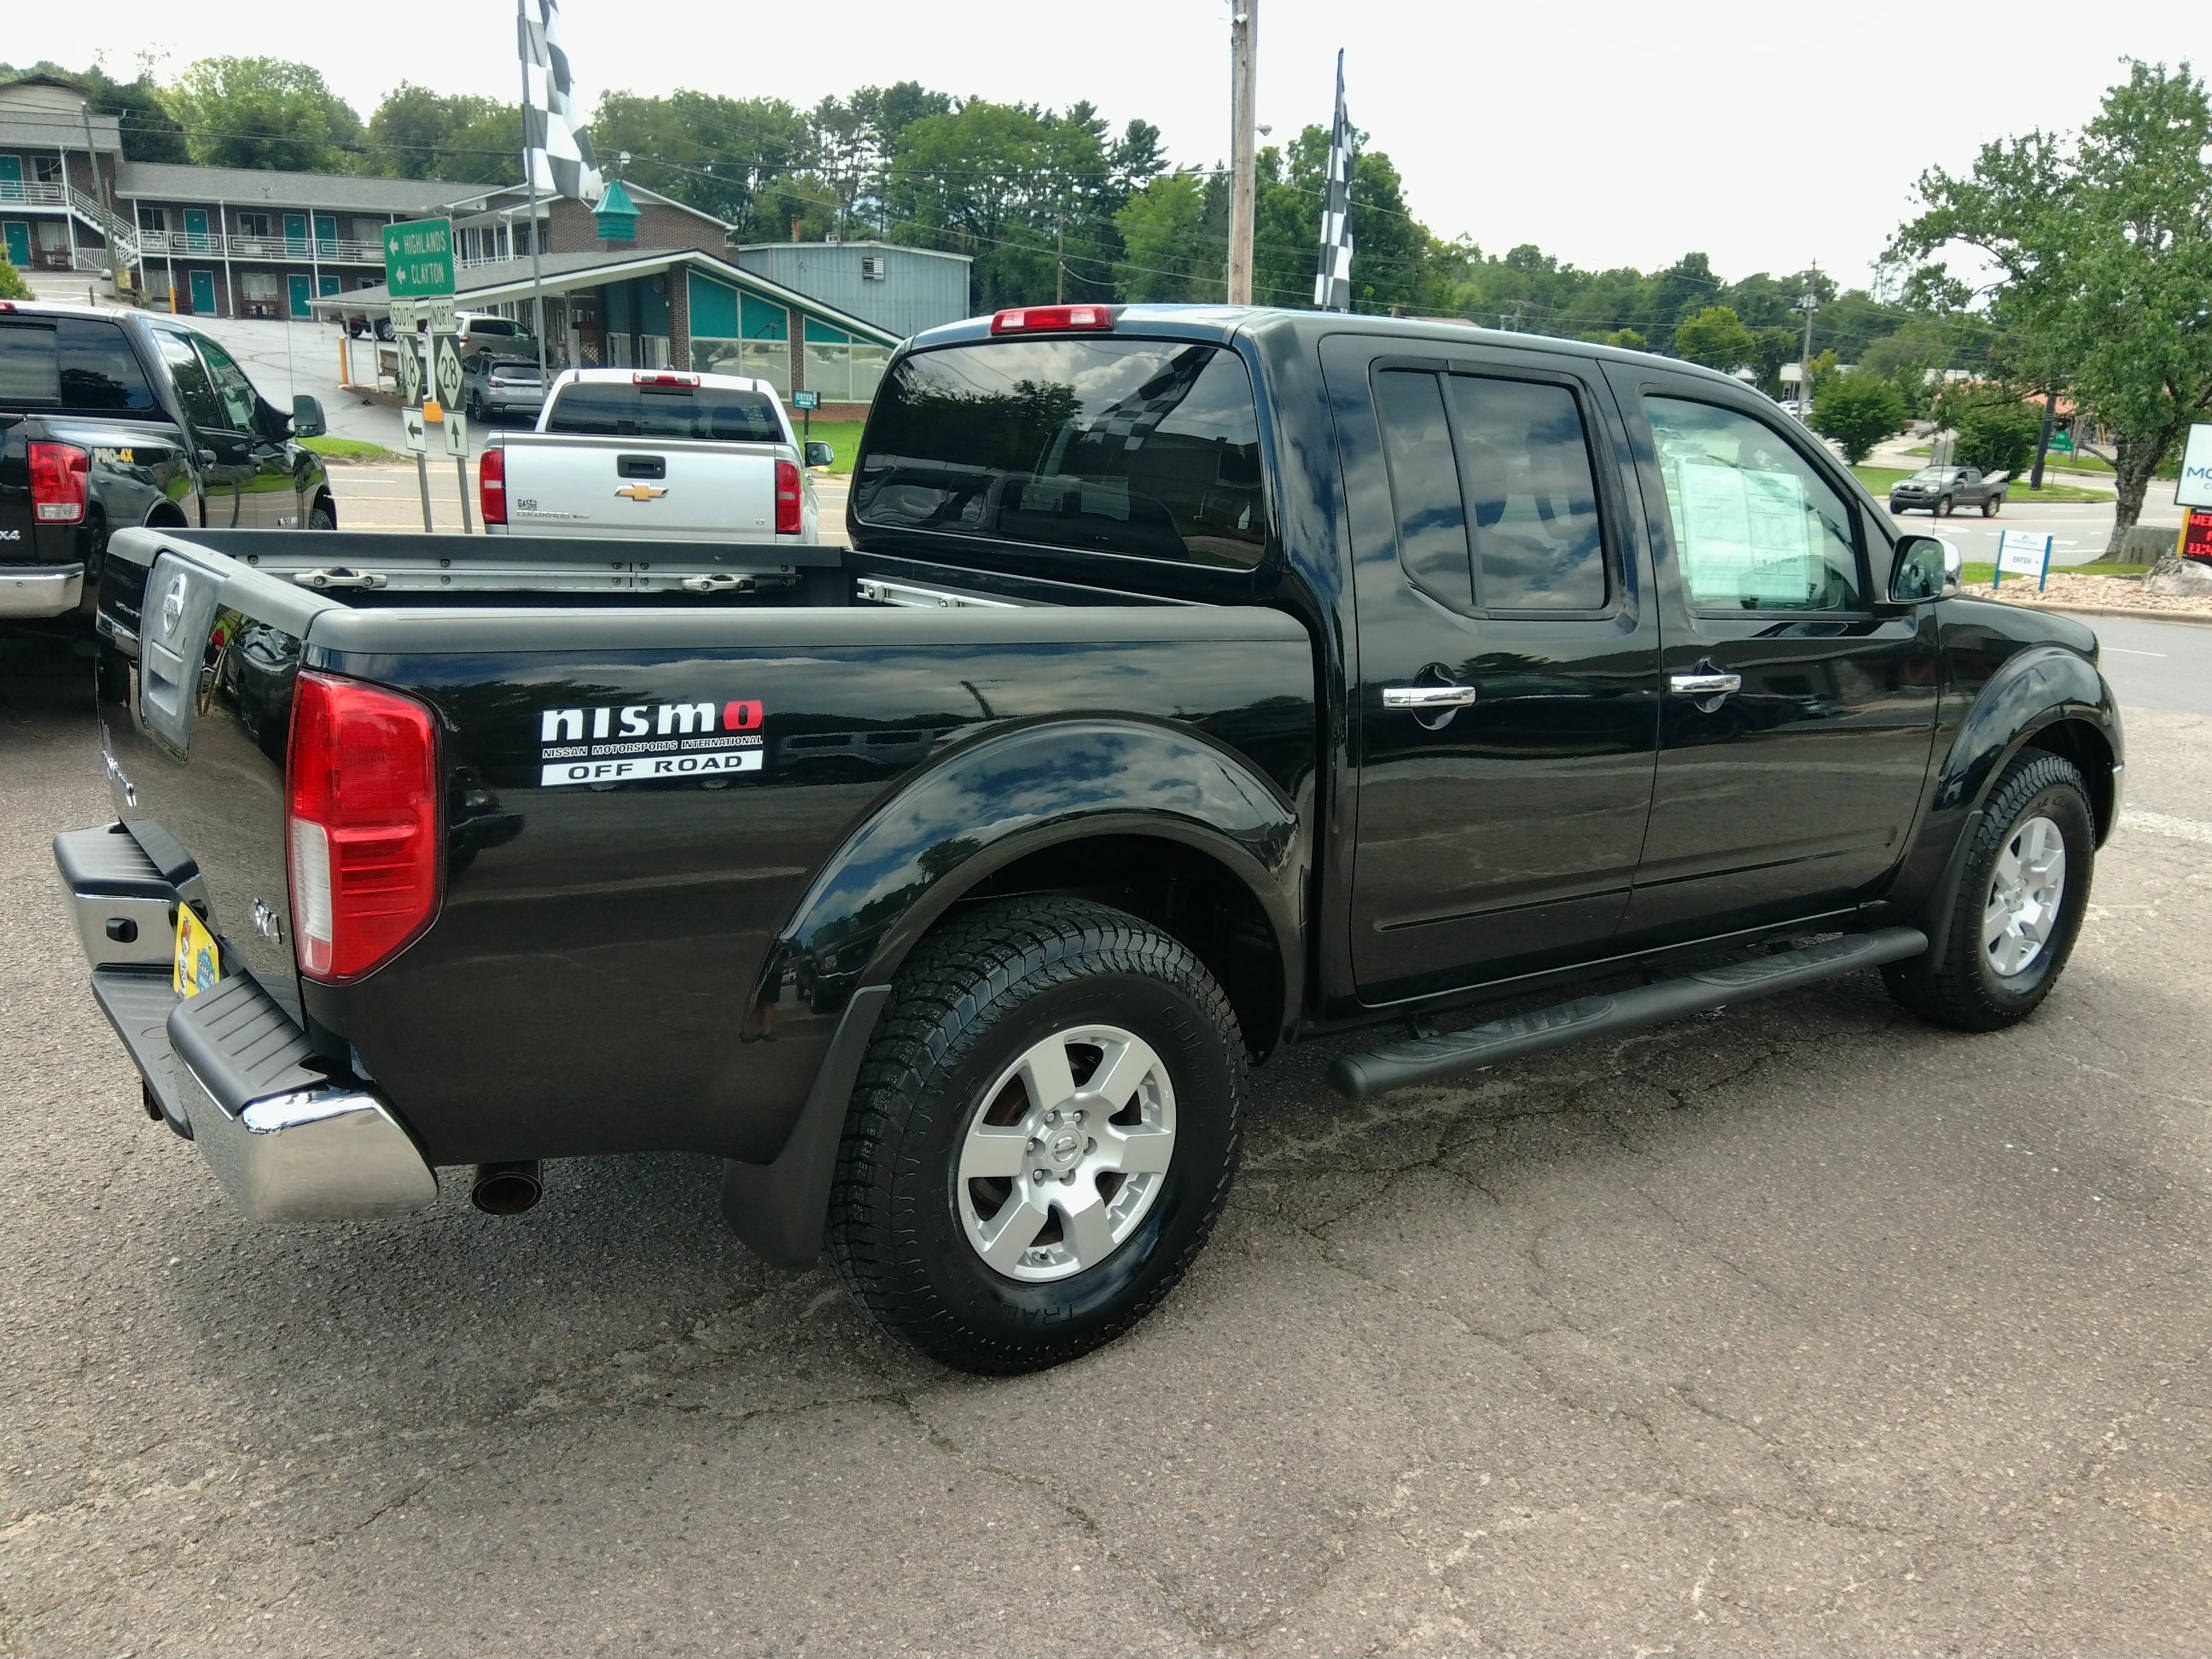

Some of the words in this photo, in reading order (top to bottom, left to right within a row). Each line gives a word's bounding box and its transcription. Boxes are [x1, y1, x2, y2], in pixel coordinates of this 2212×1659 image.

[403, 230, 446, 254] HIGHLANDS
[410, 262, 444, 285] CLAYTON
[392, 306, 416, 327] SOUTH
[432, 306, 455, 326] NORTH
[440, 356, 458, 390] 28
[796, 393, 813, 402] ENTER
[94, 448, 134, 463] PRO-4X
[2012, 556, 2032, 565] ENTER
[542, 745, 588, 759] NISSAN
[591, 740, 678, 755] MOTORSPORTS
[681, 735, 764, 750] INTERNATIONAL
[568, 762, 634, 780] OFF
[654, 755, 743, 774] ROAD
